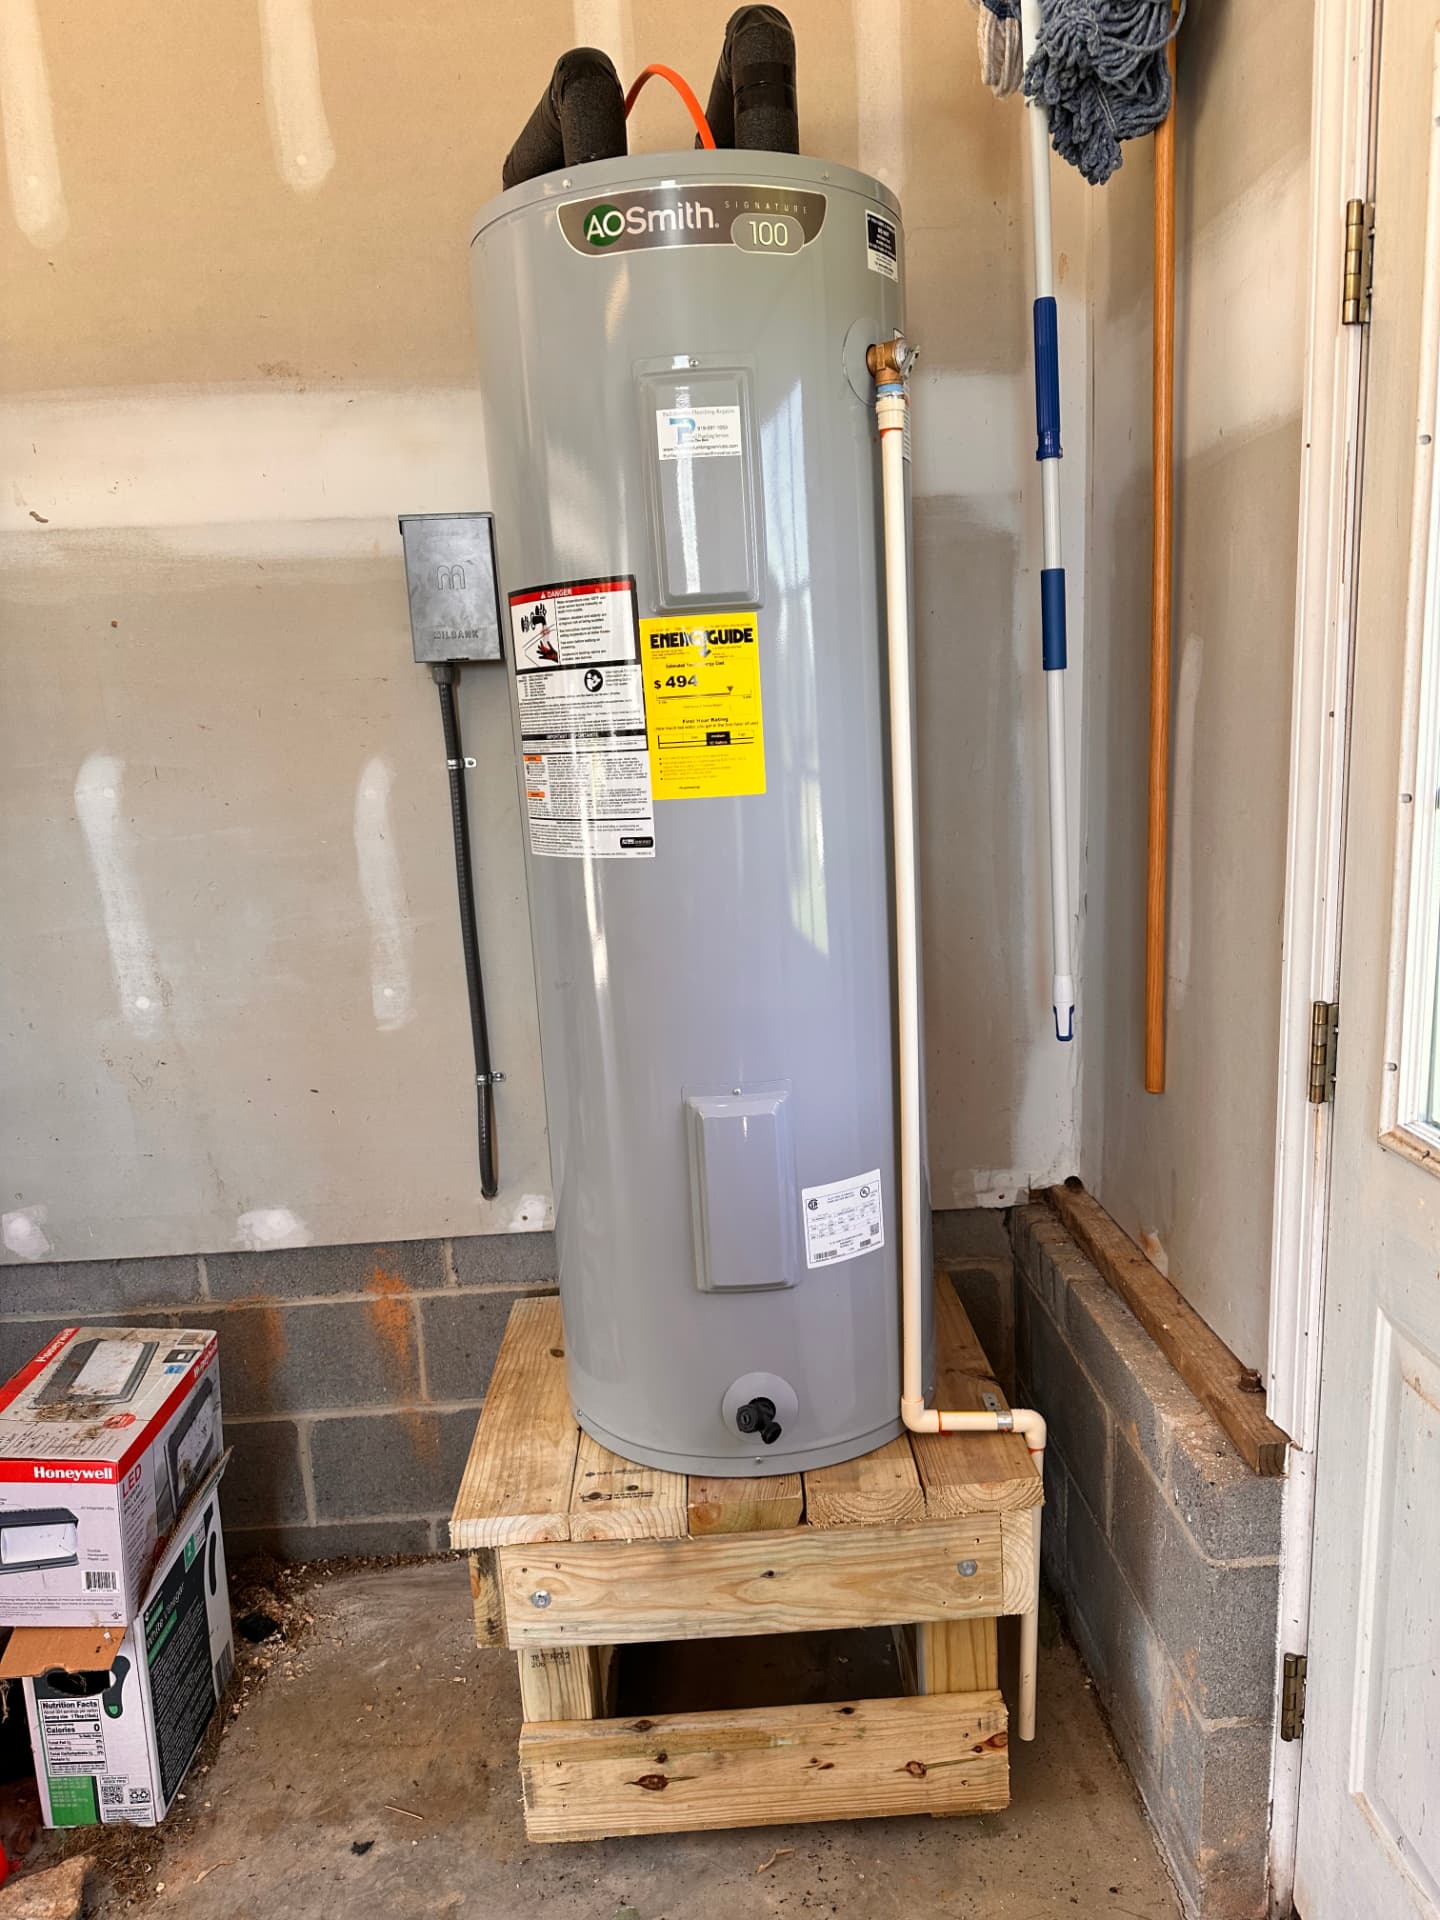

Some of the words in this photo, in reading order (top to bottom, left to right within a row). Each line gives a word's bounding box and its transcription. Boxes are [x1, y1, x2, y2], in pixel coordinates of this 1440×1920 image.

[724, 200, 808, 216] SIGNATURE
[748, 220, 789, 247] 100
[546, 587, 574, 599] DANGER
[432, 629, 480, 641] MILBANK
[654, 680, 662, 689] $
[665, 675, 698, 688] 494
[33, 1465, 113, 1482] Honeywell
[122, 1463, 143, 1499] LED
[46, 1726, 76, 1734] Calories
[94, 1723, 100, 1732] 0
